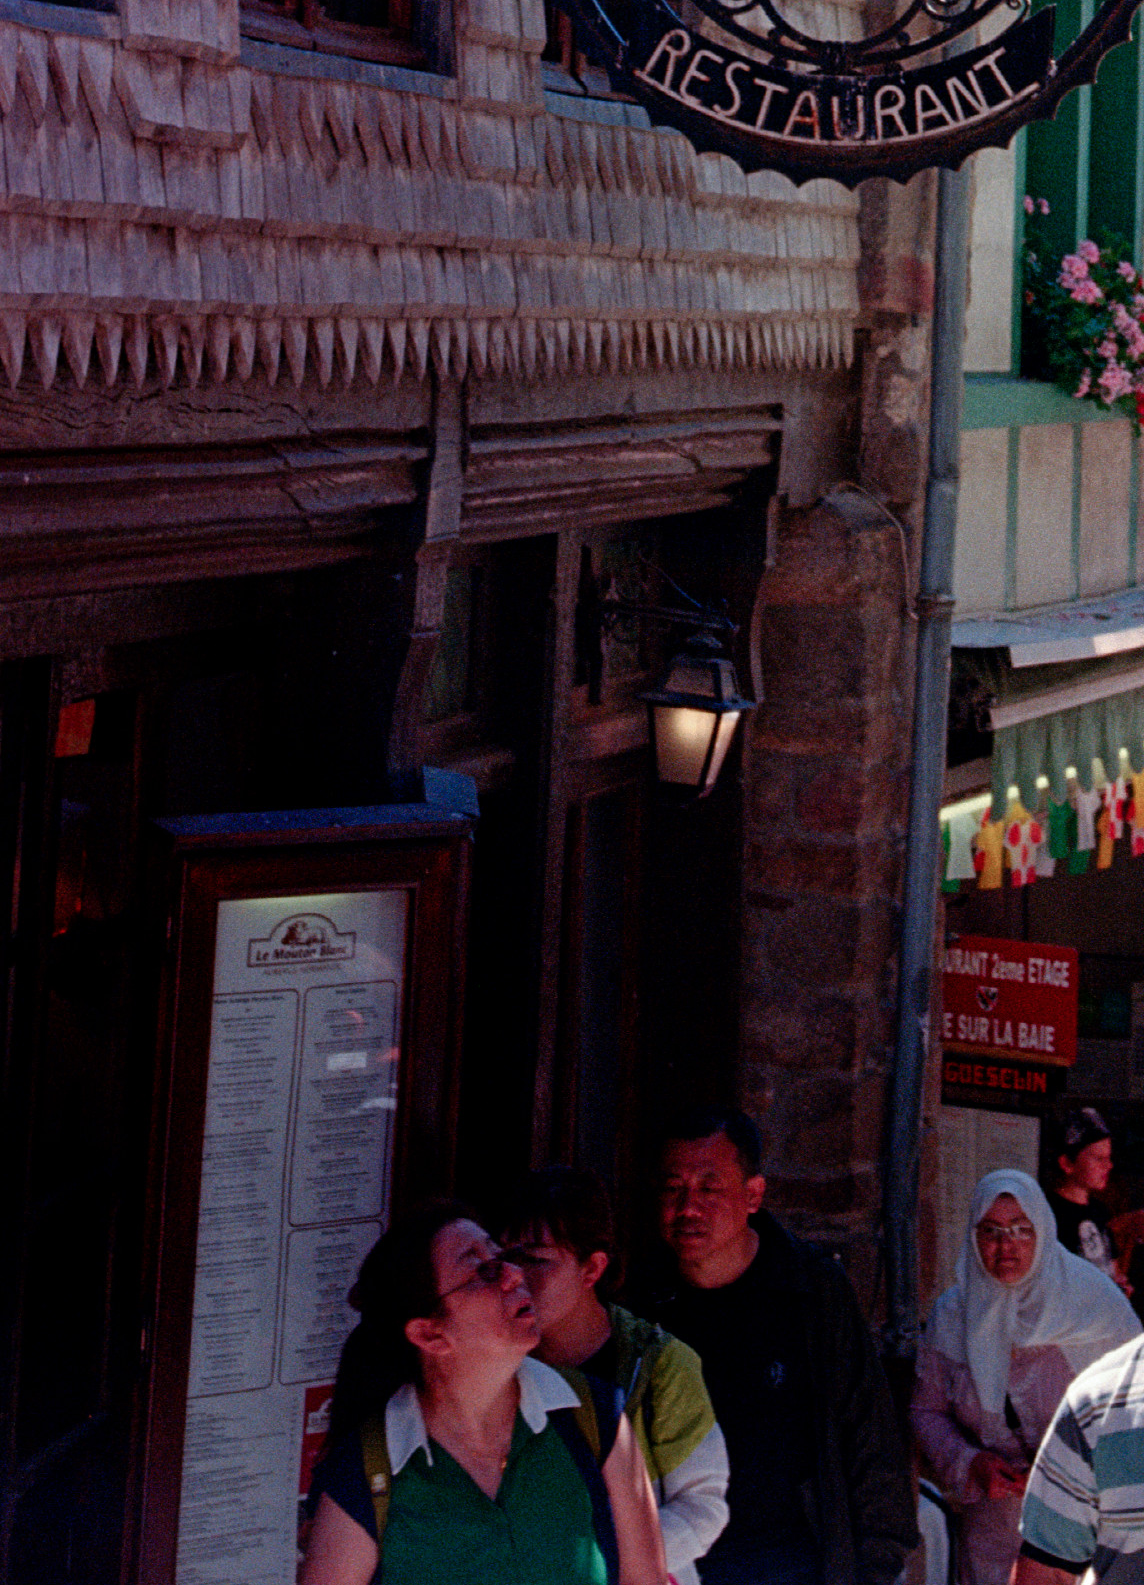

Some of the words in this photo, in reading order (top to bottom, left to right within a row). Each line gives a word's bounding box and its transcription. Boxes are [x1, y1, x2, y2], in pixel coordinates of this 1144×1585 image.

[642, 29, 1022, 141] RESTAURANT
[944, 947, 989, 978] URANT
[1028, 956, 1070, 988] ETAGE
[957, 1013, 990, 1044] SUR
[992, 1017, 1014, 1047] LA
[1017, 1021, 1056, 1052] BAIE
[943, 1061, 1048, 1093] GUESCLIN
